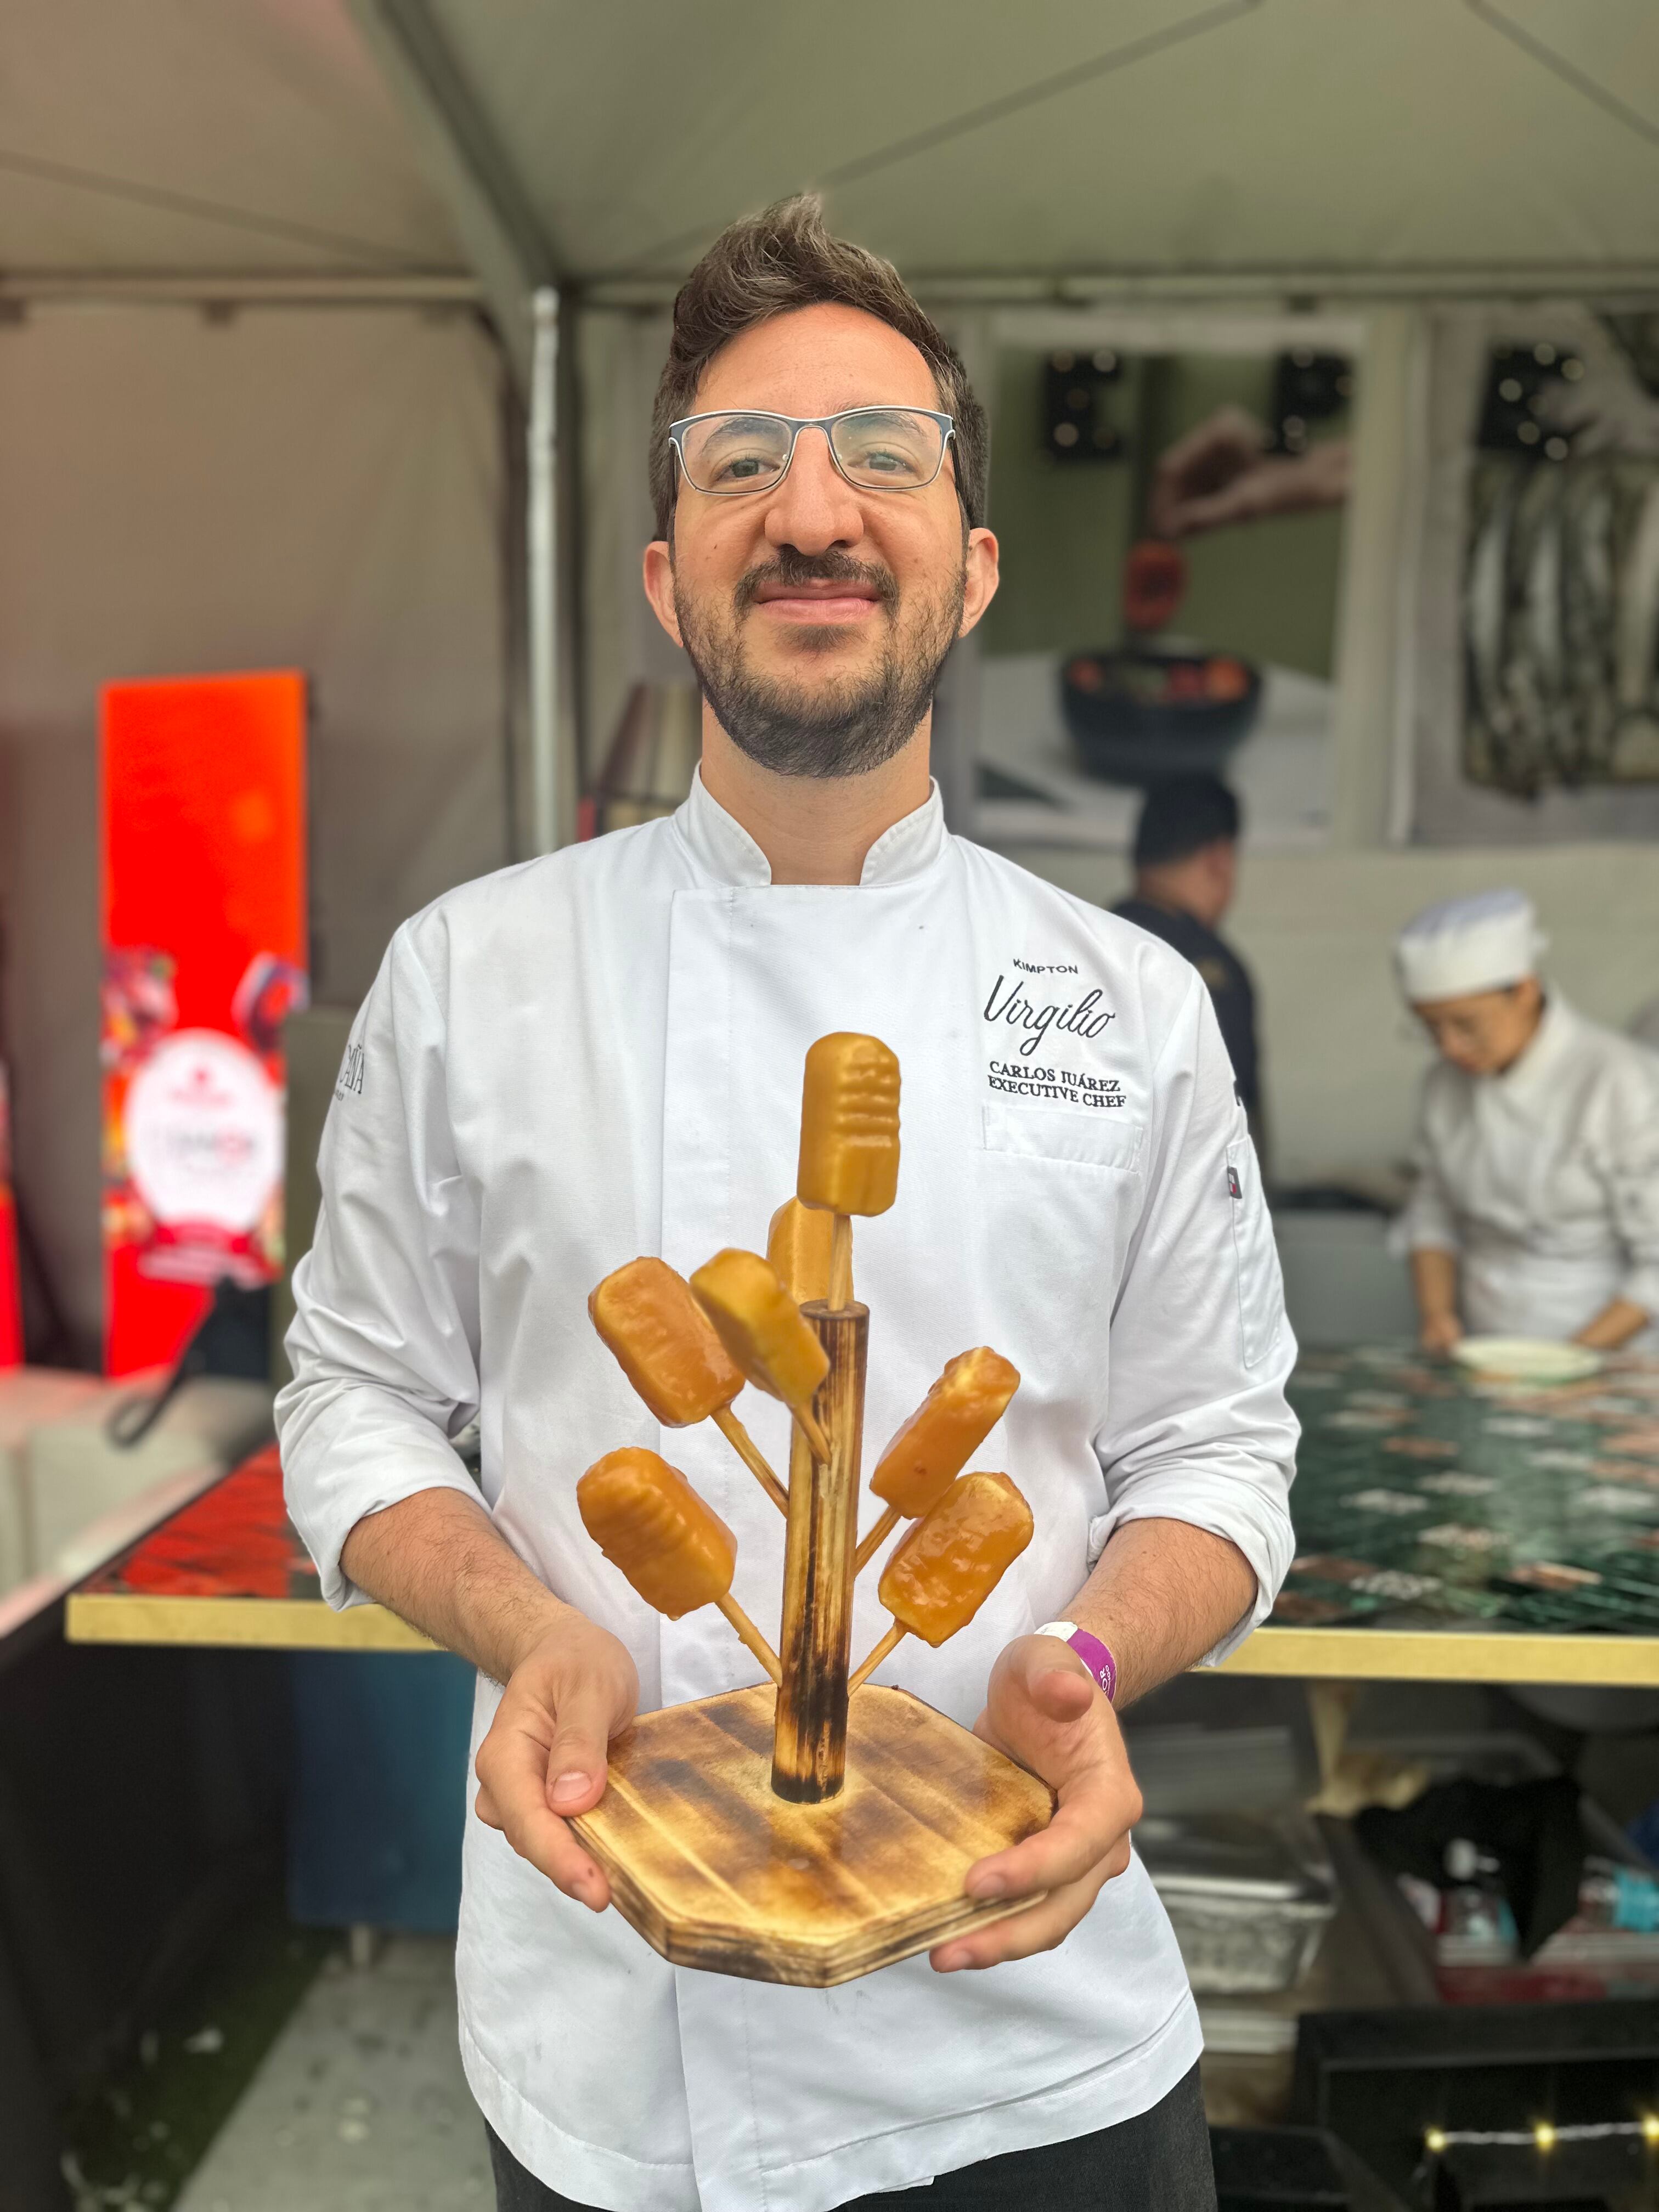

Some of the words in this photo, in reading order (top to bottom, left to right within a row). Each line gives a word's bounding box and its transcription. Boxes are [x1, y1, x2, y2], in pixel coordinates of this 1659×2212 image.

[1013, 958, 1078, 974] KIMPTON
[984, 975, 1115, 1056] Virgilio
[988, 1075, 1079, 1103] EXECUTIVE
[1083, 1093, 1126, 1107] CHEF
[990, 1061, 1056, 1081] CARLOS
[1061, 1071, 1120, 1092] JUÁREZ
